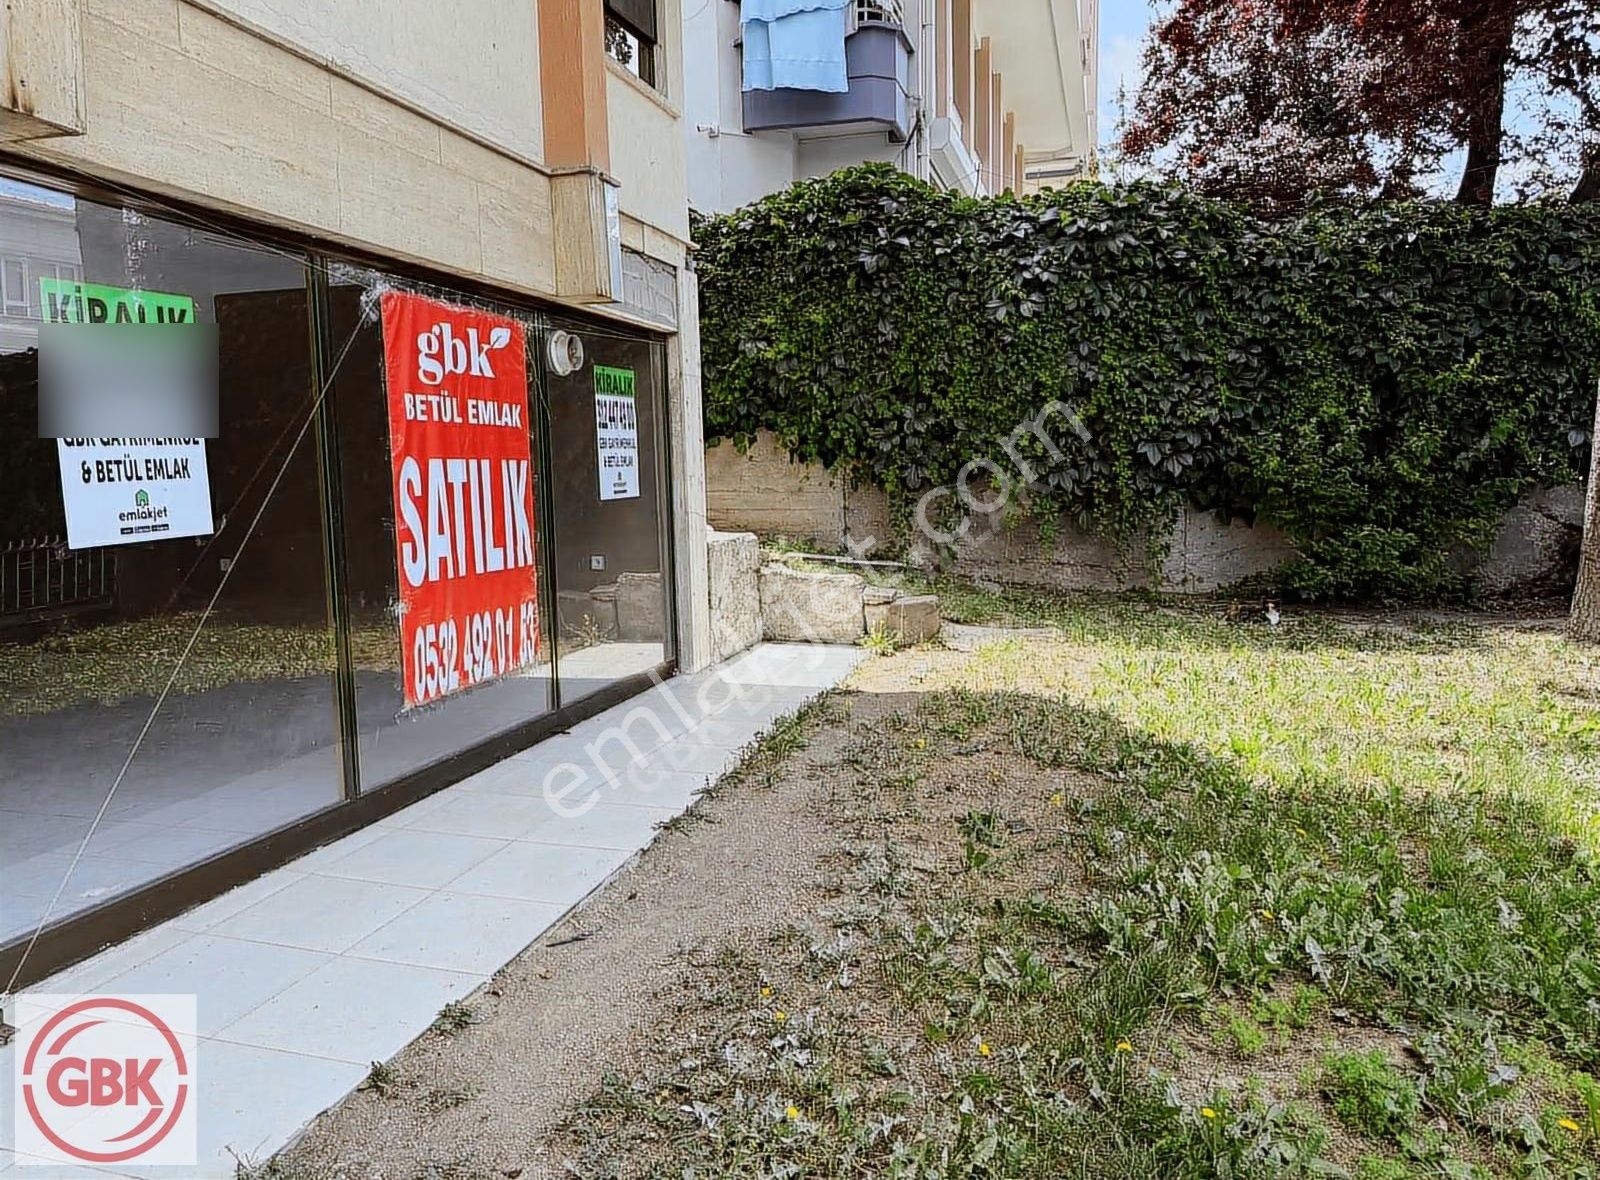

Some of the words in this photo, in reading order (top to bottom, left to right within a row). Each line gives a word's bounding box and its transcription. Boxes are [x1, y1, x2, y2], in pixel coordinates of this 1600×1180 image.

[417, 321, 496, 386] gbk
[594, 367, 633, 397] KİRALIK
[404, 389, 463, 423] BETÜL
[467, 398, 522, 428] EMLAK
[81, 460, 92, 483] &
[96, 453, 142, 482] BETÜL
[145, 458, 190, 480] EMLAK
[119, 506, 168, 521] emlakjet
[398, 456, 533, 587] SATILIK
[414, 617, 460, 704] 0532
[463, 611, 493, 685] 492
